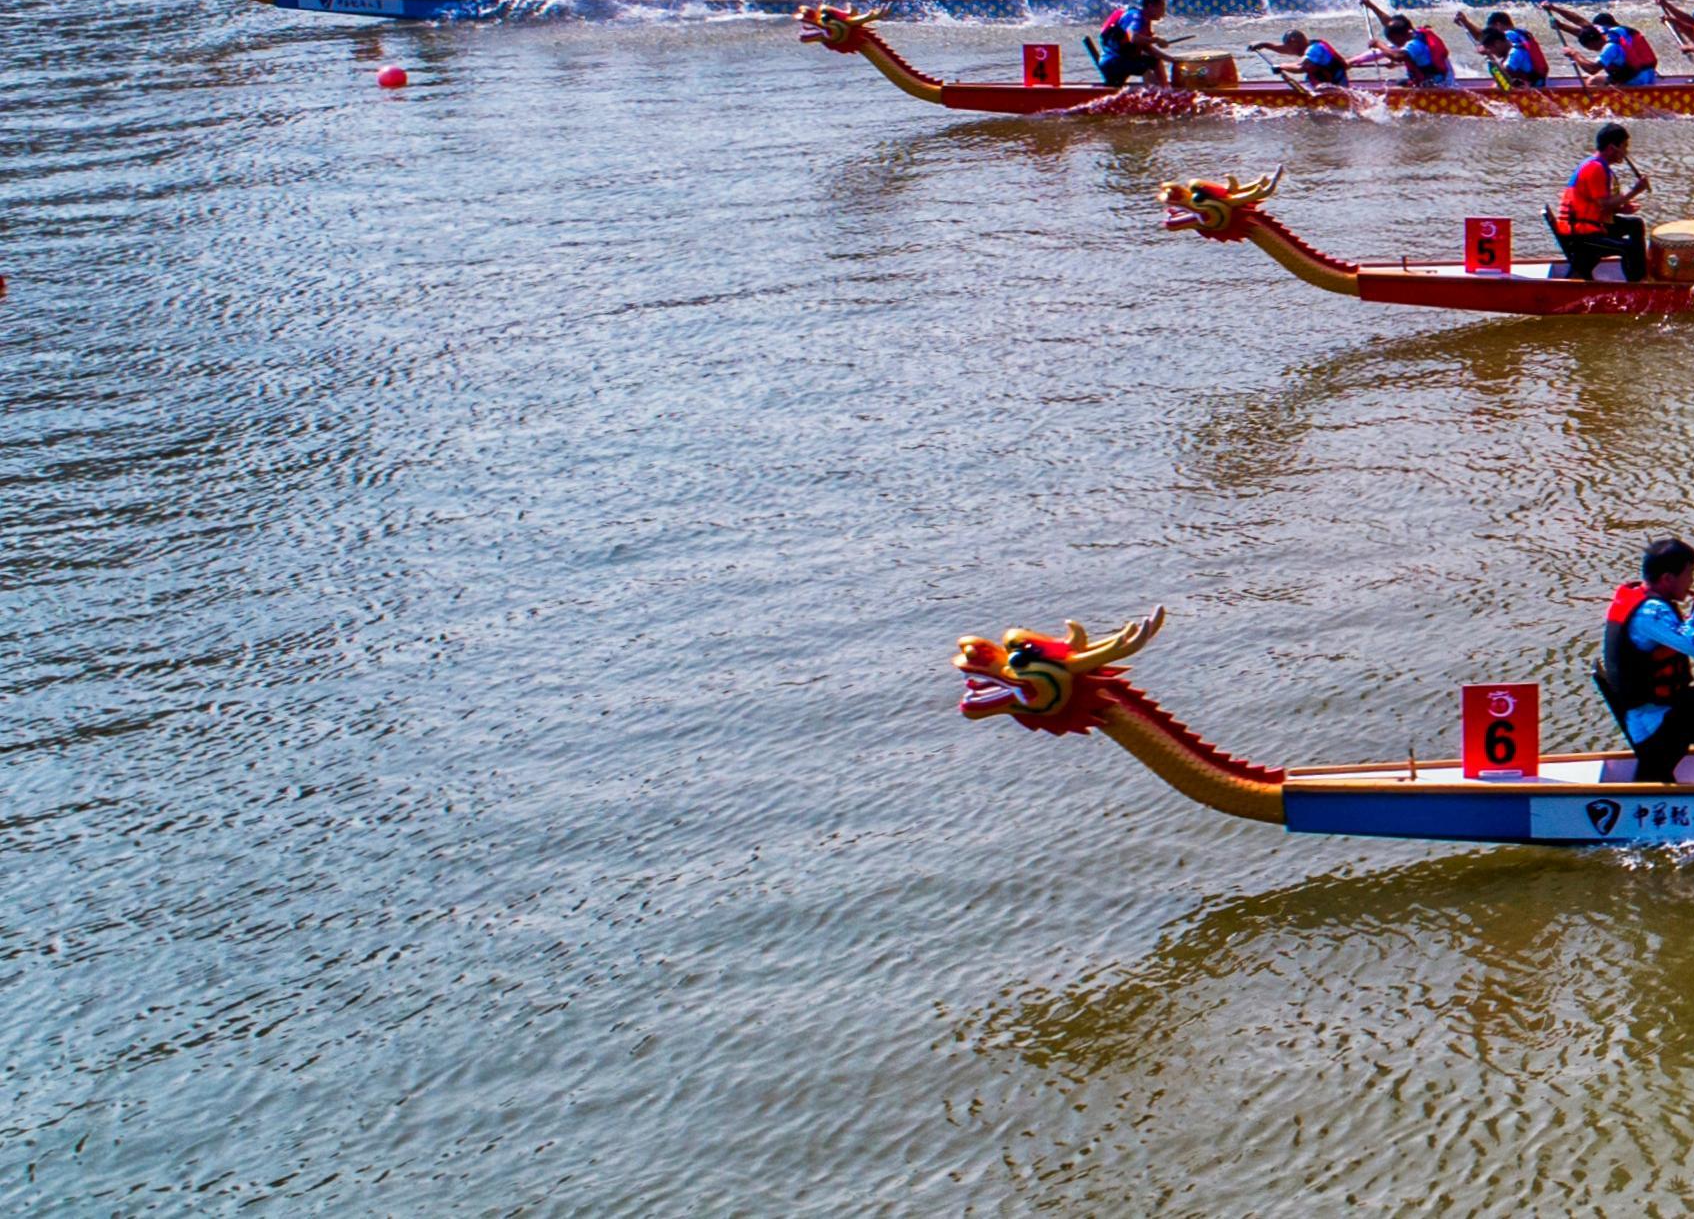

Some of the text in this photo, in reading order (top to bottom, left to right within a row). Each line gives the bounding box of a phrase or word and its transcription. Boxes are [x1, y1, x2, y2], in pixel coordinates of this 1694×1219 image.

[1032, 61, 1048, 81] 4
[1477, 238, 1496, 266] 5
[1485, 719, 1516, 765] 6
